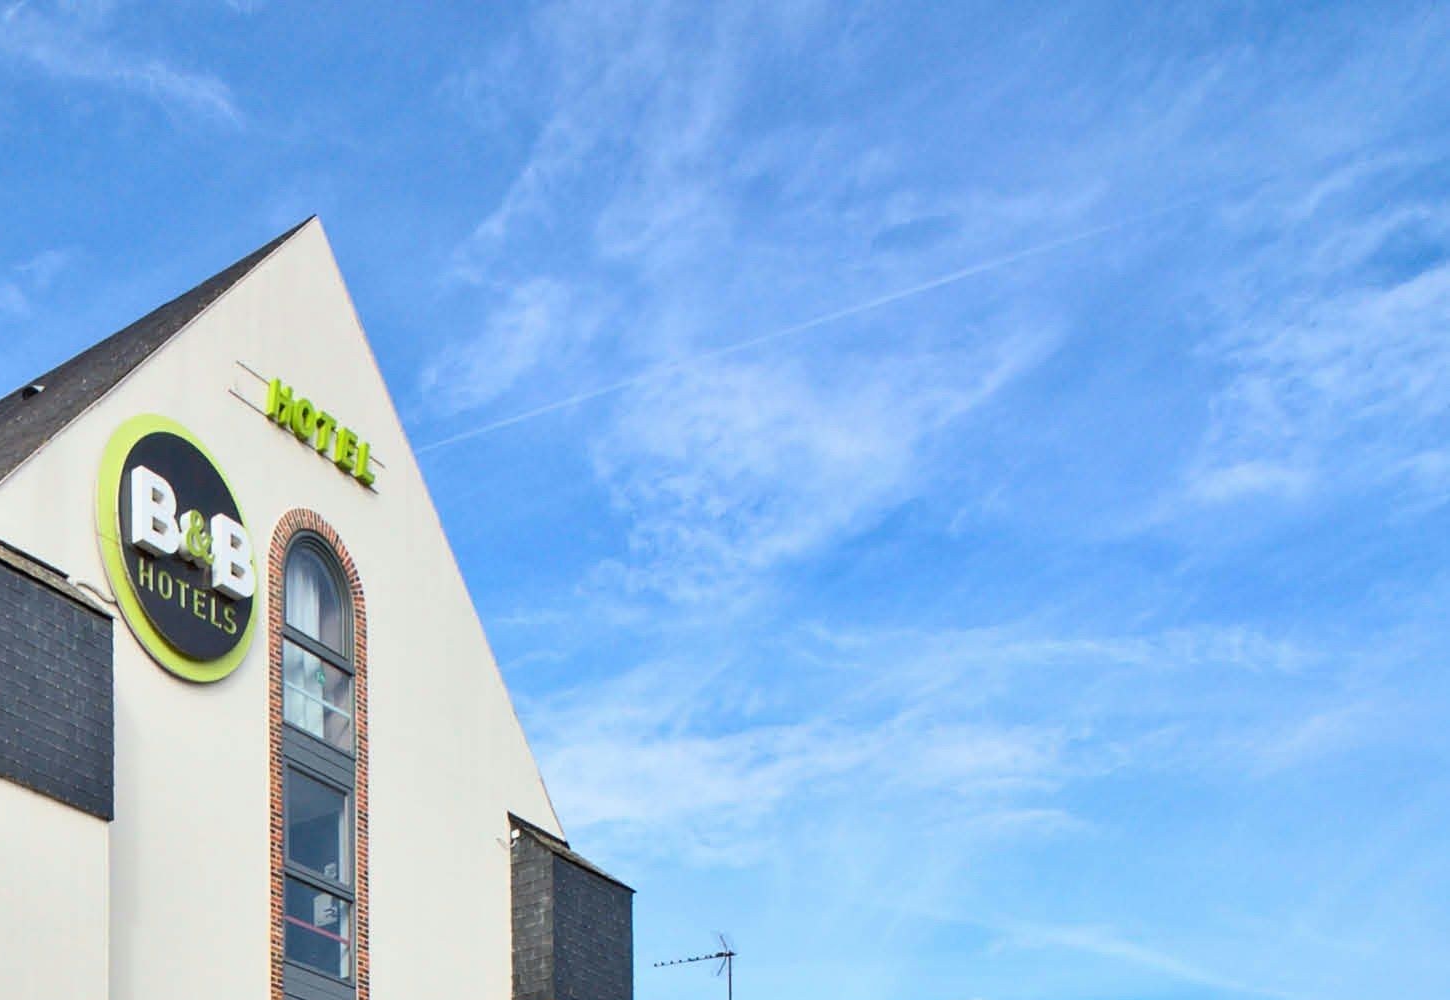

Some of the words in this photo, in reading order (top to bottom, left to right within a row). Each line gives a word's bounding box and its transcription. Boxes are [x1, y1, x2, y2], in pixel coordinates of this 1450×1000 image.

[266, 377, 375, 486] HOTEL
[131, 464, 256, 600] B&B
[138, 556, 238, 635] HOTELS
